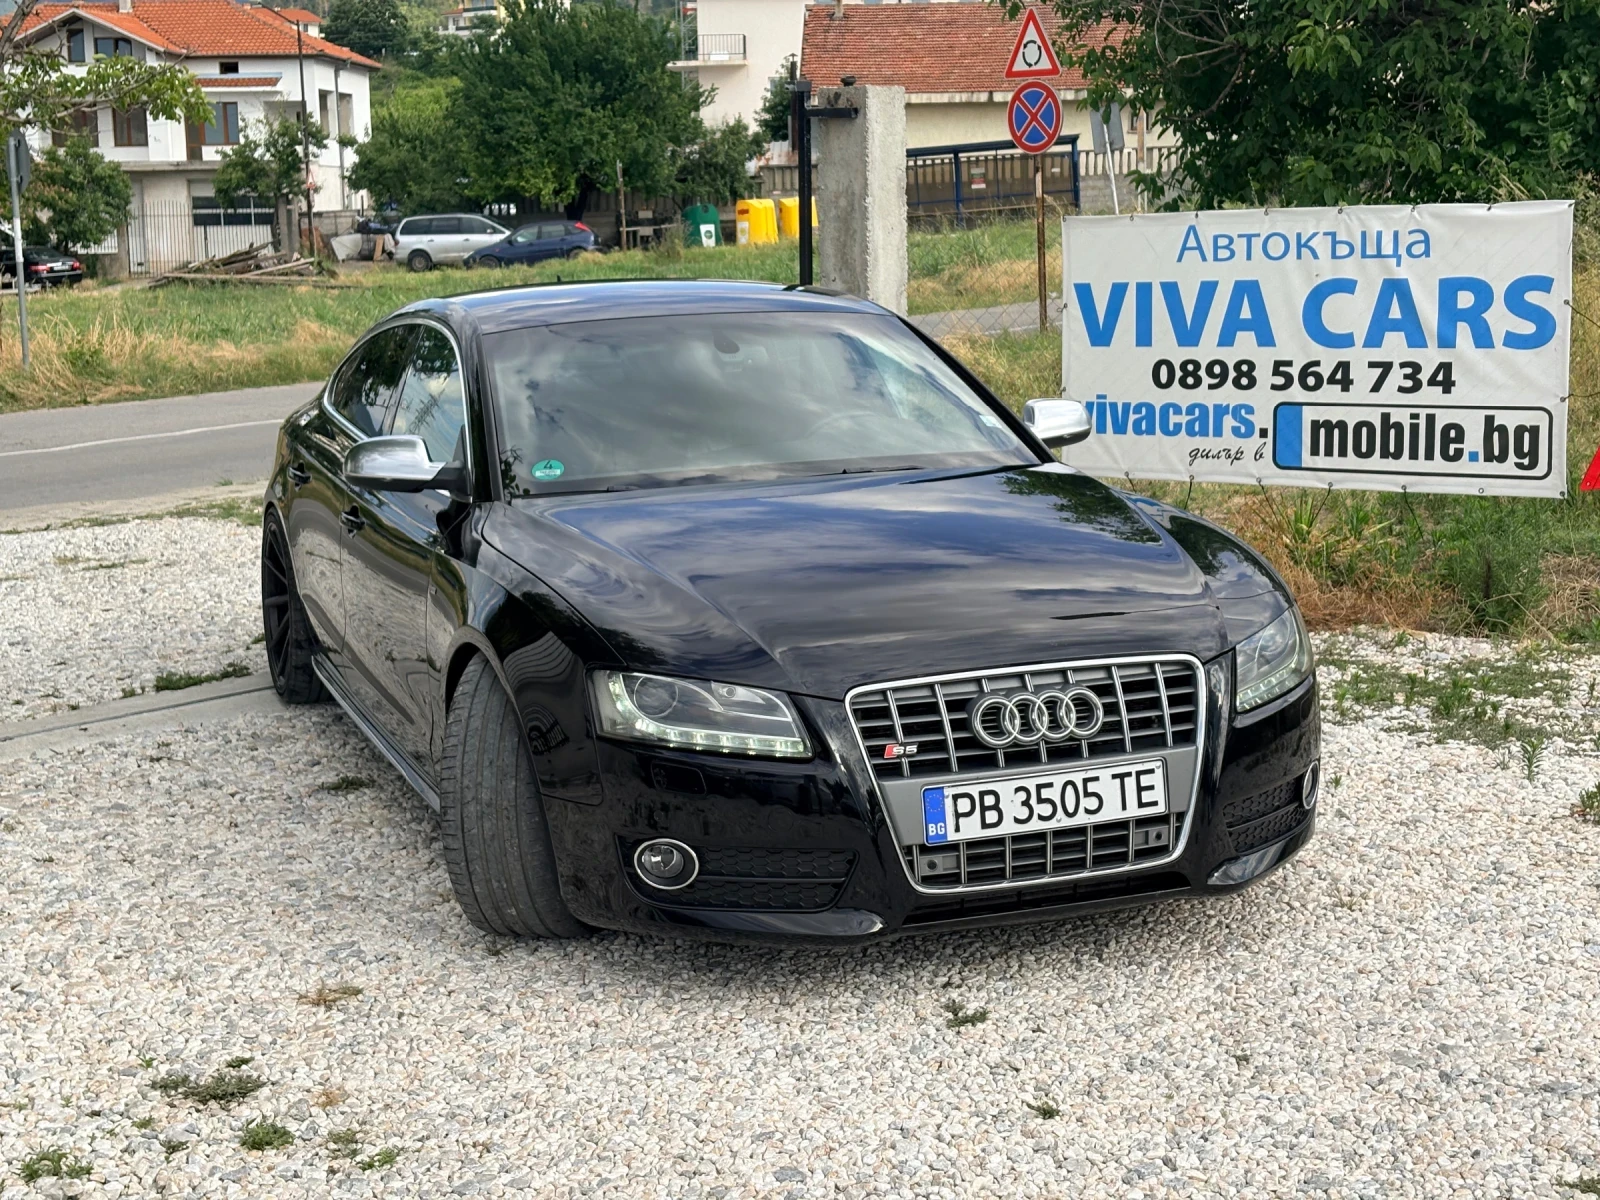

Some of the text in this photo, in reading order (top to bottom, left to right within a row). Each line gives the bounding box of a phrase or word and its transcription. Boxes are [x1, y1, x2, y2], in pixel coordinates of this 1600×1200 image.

[1176, 224, 1431, 267] Автокъща
[1073, 275, 1557, 349] VIVA CARS
[1152, 358, 1456, 394] 0898 564 734
[1188, 442, 1267, 466] дилър в
[1309, 412, 1541, 471] mobile.bg
[891, 744, 918, 756] S5
[952, 768, 1159, 833] PB 3505 TE
[928, 822, 945, 836] BG
